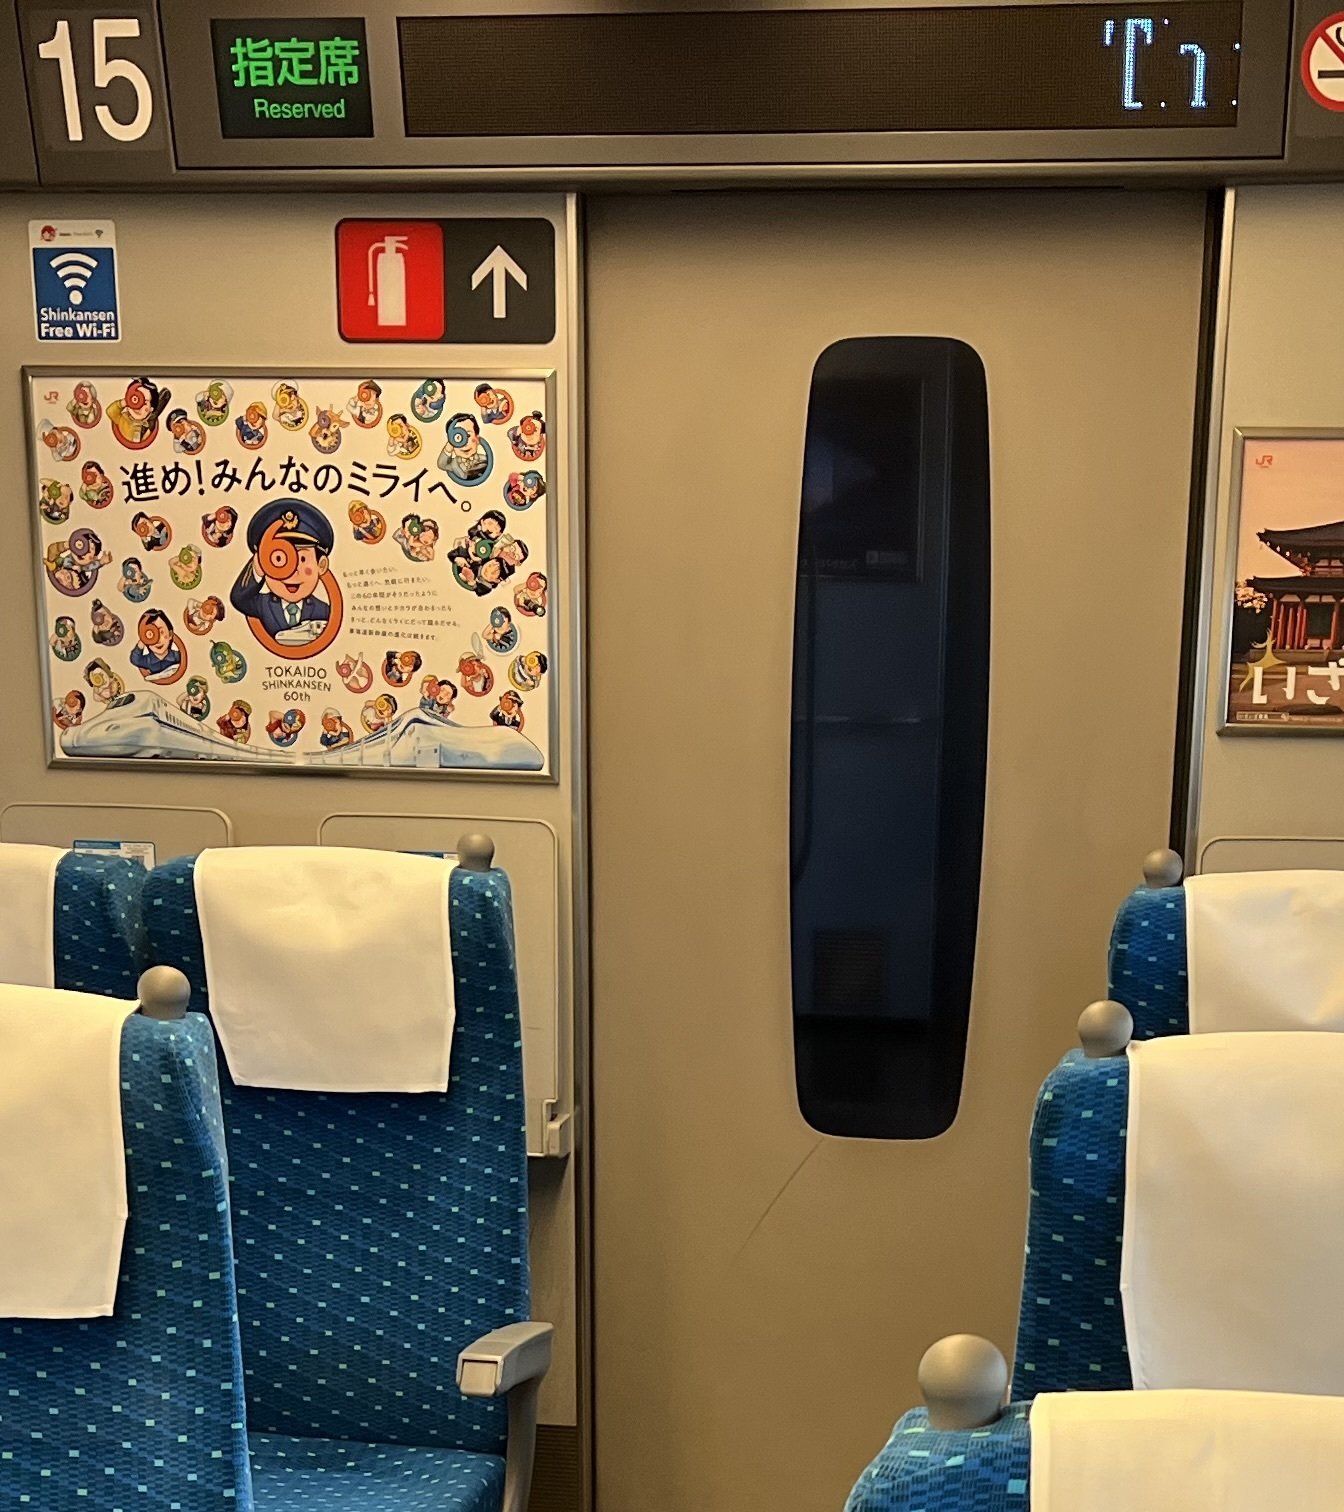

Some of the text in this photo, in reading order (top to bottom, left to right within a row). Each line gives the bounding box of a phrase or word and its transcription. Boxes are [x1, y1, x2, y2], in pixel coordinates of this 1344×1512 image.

[229, 36, 360, 88] 指定席
[38, 18, 153, 142] 15
[253, 98, 346, 119] Reserved
[40, 307, 115, 321] Shinkansen
[40, 321, 116, 337] Free Wi-Fi
[265, 666, 327, 679] TOKAIDO
[262, 679, 332, 692] SHINKANSEN
[283, 691, 311, 702] 60th
